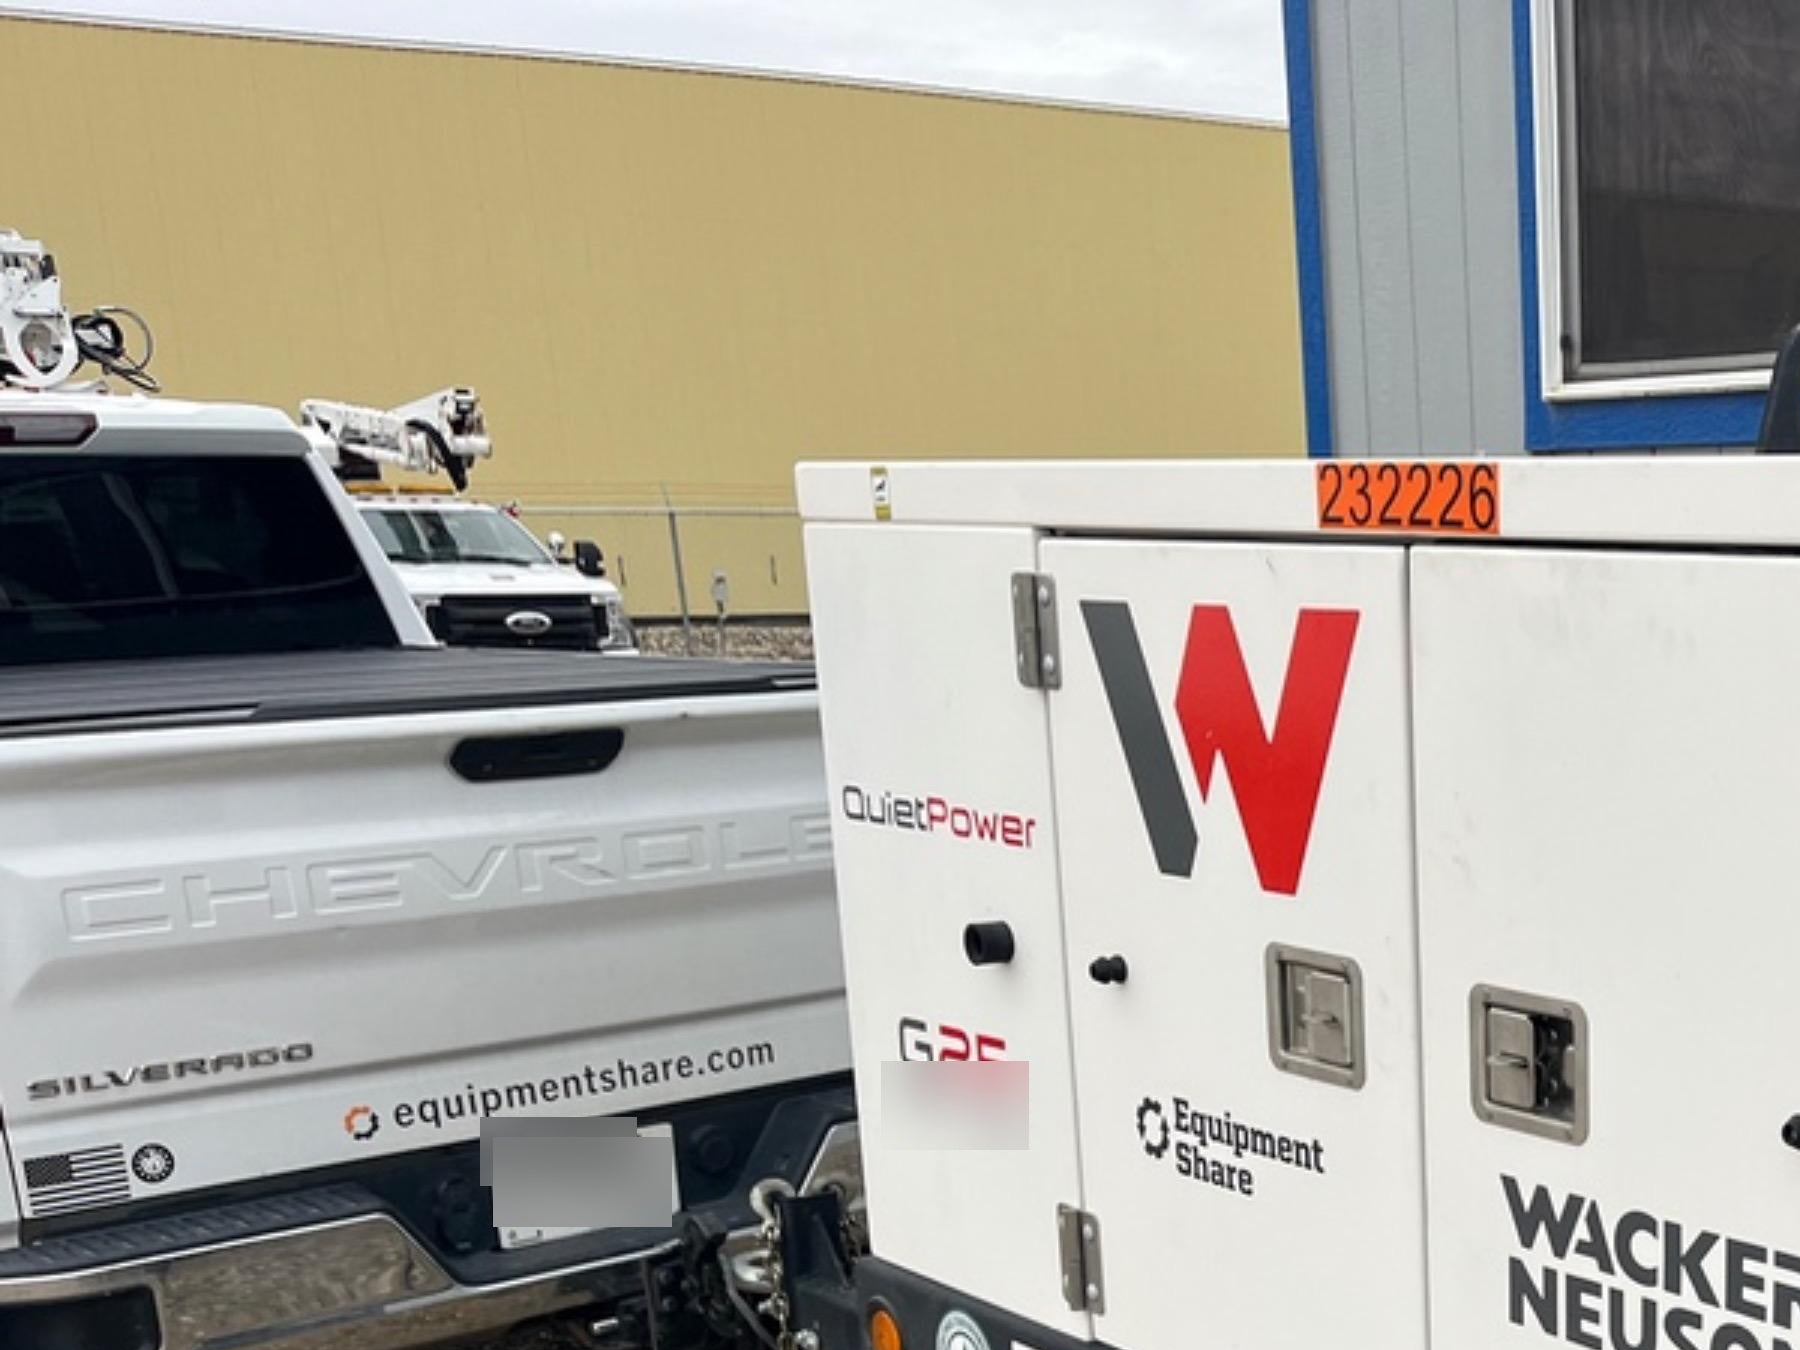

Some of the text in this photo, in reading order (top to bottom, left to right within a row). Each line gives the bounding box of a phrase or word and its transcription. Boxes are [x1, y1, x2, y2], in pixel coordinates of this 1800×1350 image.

[1318, 462, 1495, 529] 232226
[1079, 600, 1360, 896] W
[842, 785, 1035, 848] QuietPower
[27, 1043, 313, 1100] SILVERADO
[393, 1037, 775, 1131] equipmentshare.com
[1172, 1097, 1325, 1174] Equipment
[1175, 1141, 1254, 1195] Share
